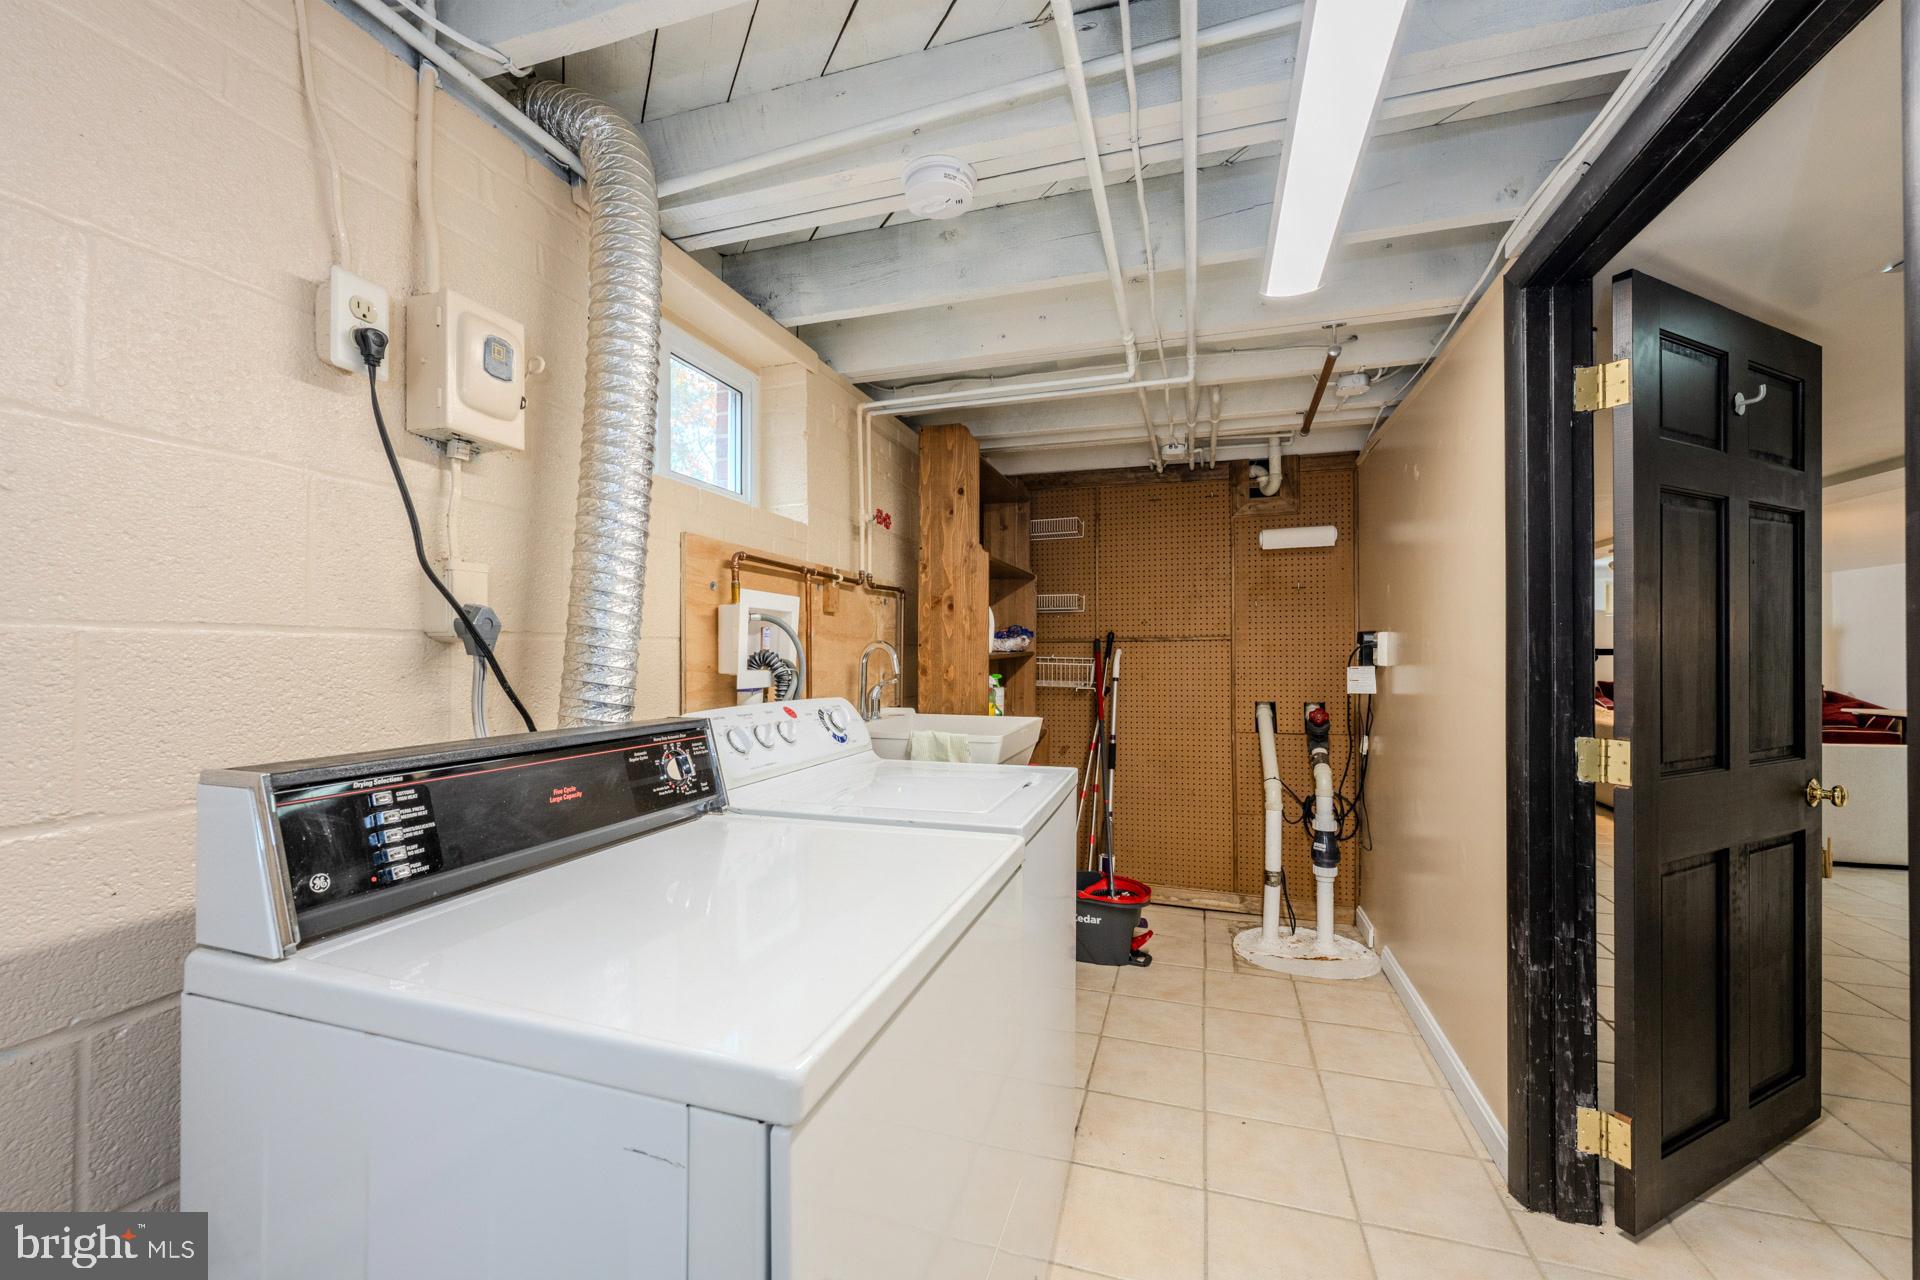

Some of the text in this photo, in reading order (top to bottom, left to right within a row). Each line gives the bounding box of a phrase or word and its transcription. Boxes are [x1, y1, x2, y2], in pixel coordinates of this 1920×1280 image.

[352, 776, 404, 789] Drying Selections
[563, 786, 577, 794] Cycle
[563, 791, 583, 800] Capacity
